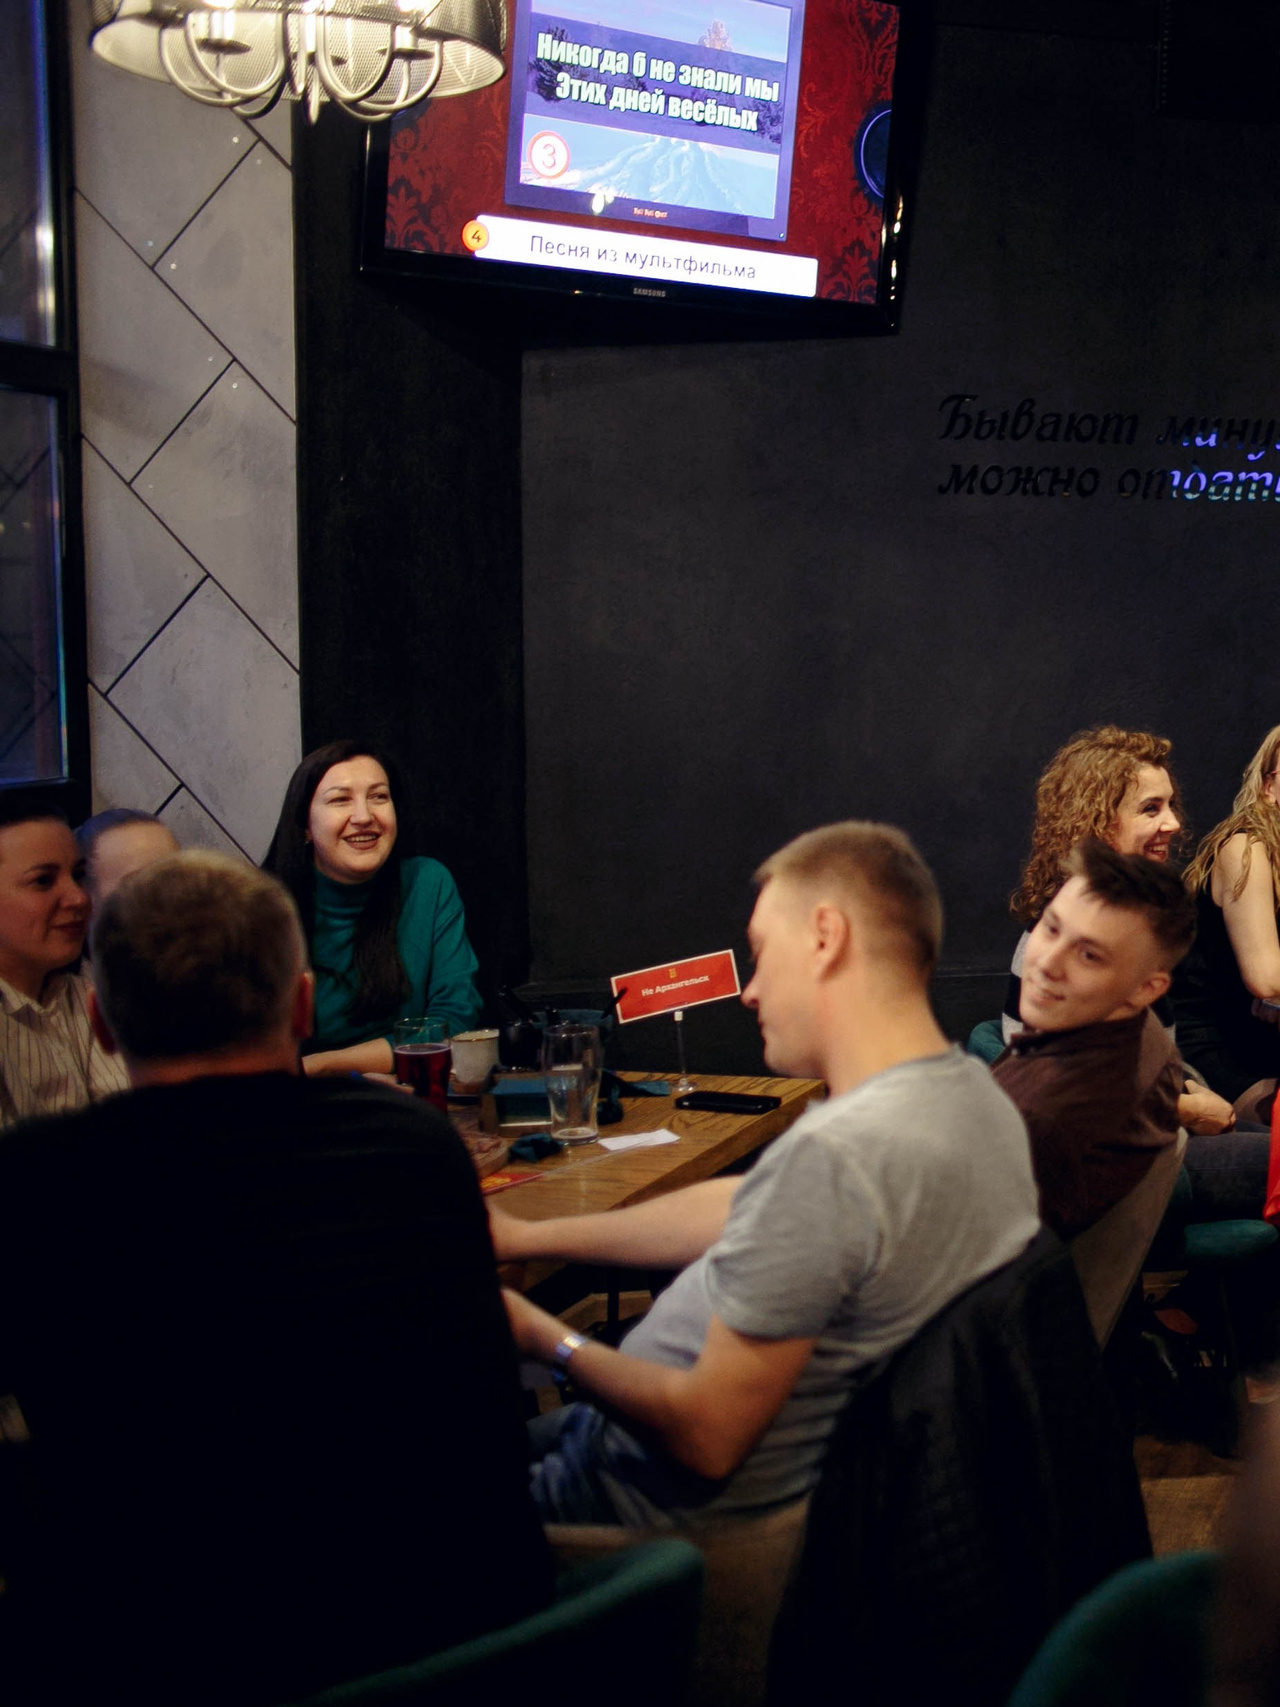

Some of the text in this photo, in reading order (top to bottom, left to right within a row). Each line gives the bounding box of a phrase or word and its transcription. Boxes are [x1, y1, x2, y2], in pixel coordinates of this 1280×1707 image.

[537, 32, 780, 102] Никогда б не знали мы
[556, 72, 759, 131] Этих дней весёлых
[542, 143, 556, 169] 3
[471, 229, 482, 243] 4
[531, 235, 757, 279] Песня из мультфильма
[938, 394, 1140, 445] Бывают
[937, 463, 1101, 498] можно
[641, 988, 654, 997] Не
